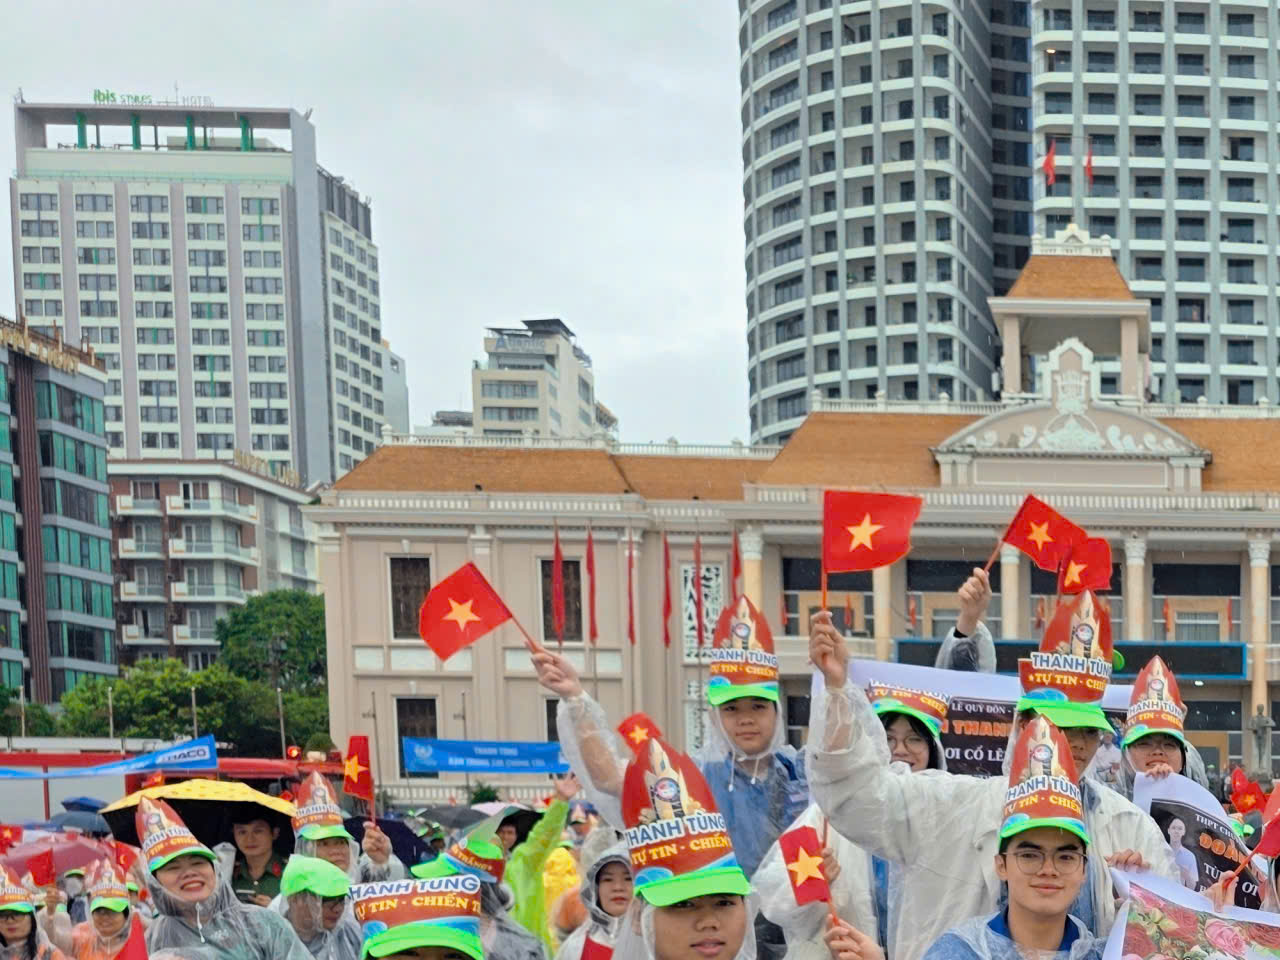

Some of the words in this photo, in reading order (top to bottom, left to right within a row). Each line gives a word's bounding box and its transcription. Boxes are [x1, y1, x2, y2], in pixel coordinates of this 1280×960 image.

[1032, 653, 1086, 672] THANH
[1035, 673, 1052, 686] TỰ
[1055, 674, 1078, 685] TIN
[1007, 776, 1046, 802] HANH
[626, 820, 683, 847] HANH
[649, 843, 678, 860] TIN
[348, 882, 411, 900] HANH
[369, 898, 399, 914] TIN
[411, 892, 469, 909] CHIẾN
